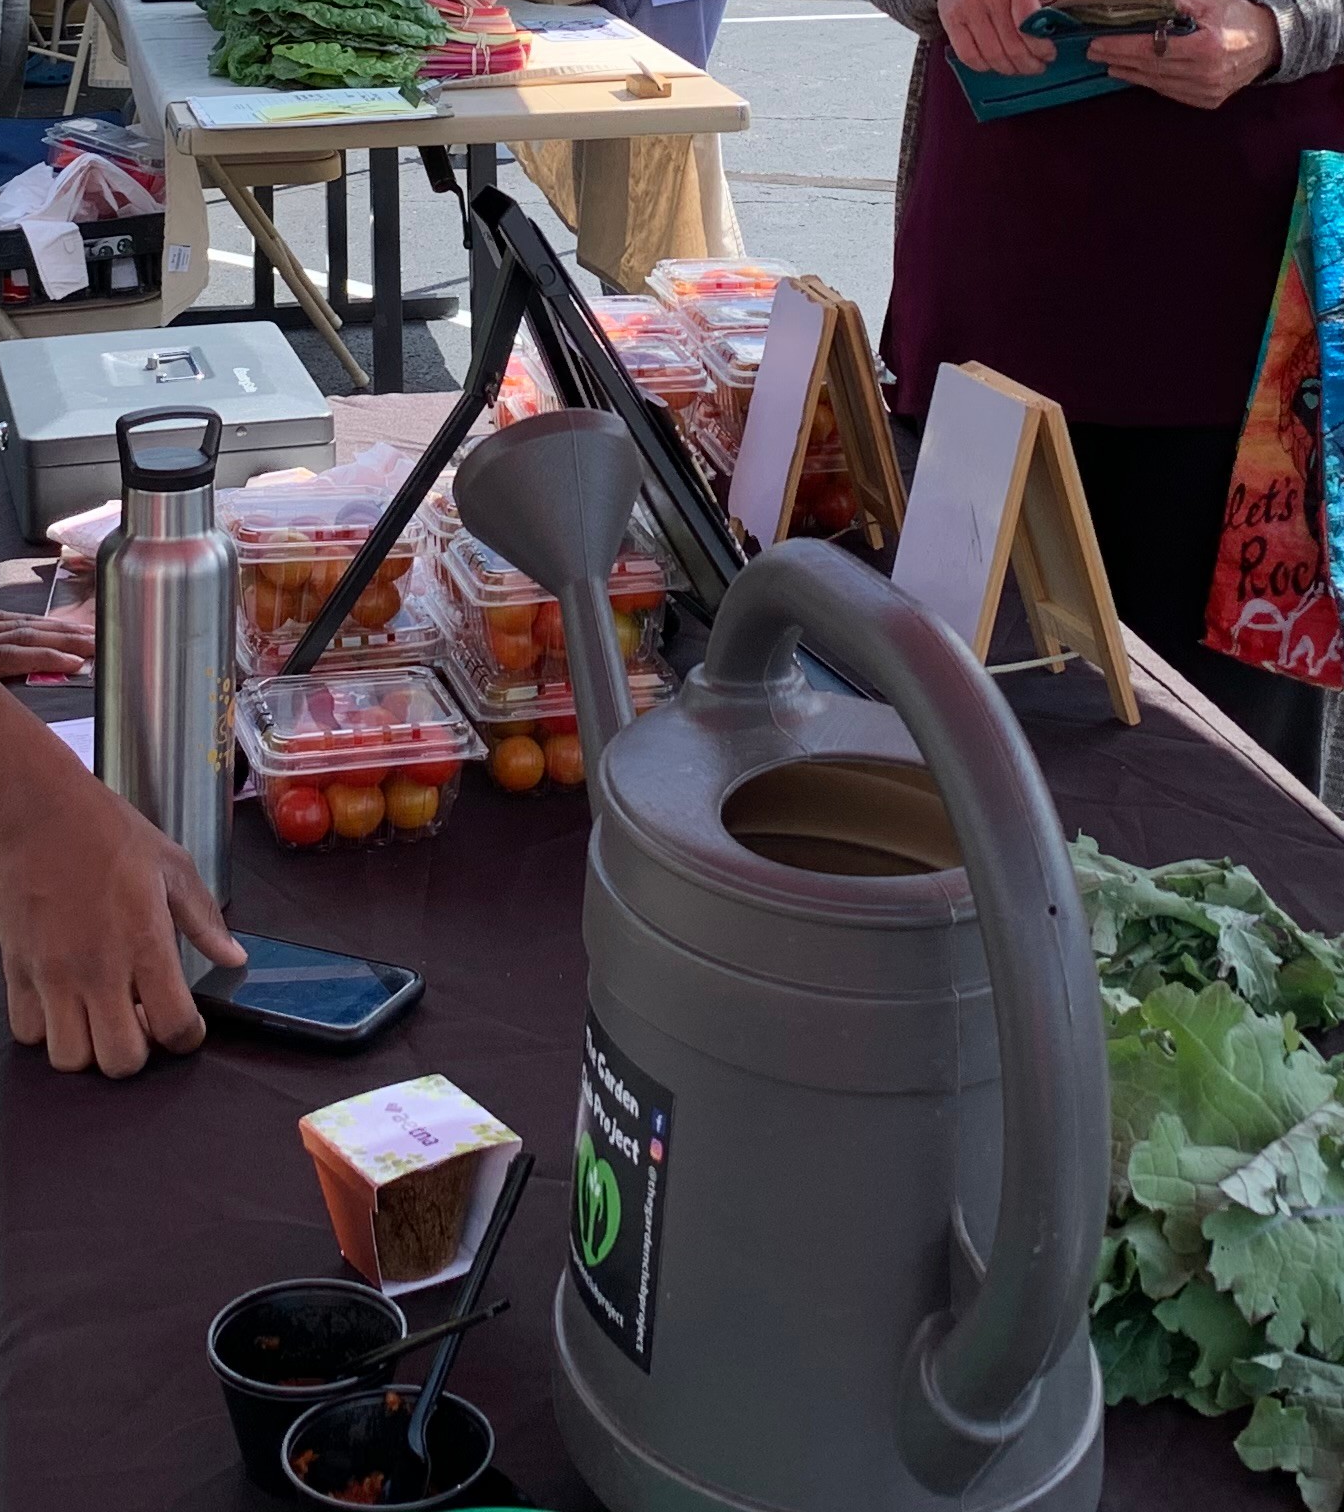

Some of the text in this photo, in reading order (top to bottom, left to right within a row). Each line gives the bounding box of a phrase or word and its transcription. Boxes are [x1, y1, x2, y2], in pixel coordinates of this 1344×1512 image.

[392, 1113, 439, 1146] aetna
[593, 1093, 640, 1166] Project
[635, 1165, 657, 1354] @thegardenclubproject
